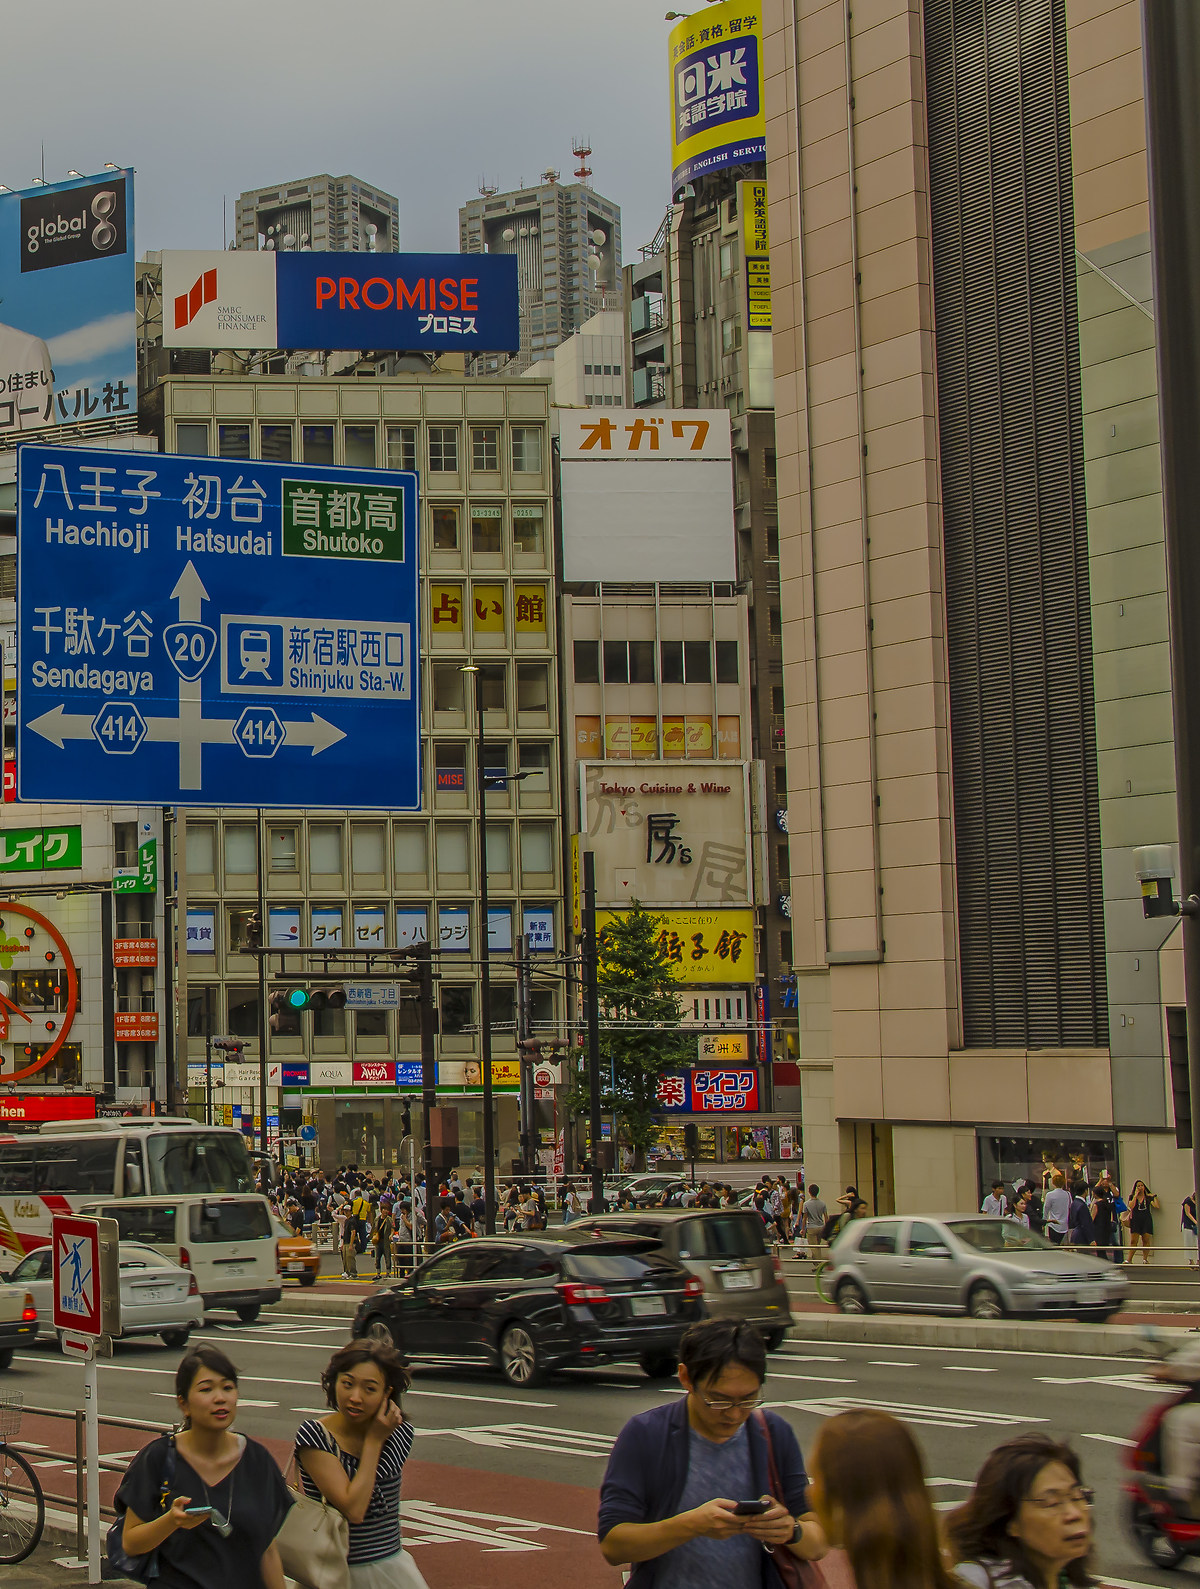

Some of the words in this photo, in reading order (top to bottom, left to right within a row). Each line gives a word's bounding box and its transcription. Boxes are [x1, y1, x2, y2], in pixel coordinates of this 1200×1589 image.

[678, 47, 747, 107] 日米
[679, 89, 748, 132] 英語学院
[693, 152, 729, 172] ENGLISH
[28, 210, 86, 253] global
[316, 277, 478, 311] PROMISE
[217, 314, 266, 322] CONSUMER
[217, 322, 256, 330] FINANCE
[417, 314, 478, 335] プロミス
[579, 417, 709, 450] オガワ
[34, 464, 161, 515] 八王子
[182, 471, 267, 523] 初台
[289, 488, 397, 532] 首都高
[46, 518, 149, 554] Hachioji
[176, 526, 272, 556] Hatsudai
[303, 530, 384, 555] Shutoko
[433, 593, 544, 623] 占い館
[33, 606, 153, 658] 千駄ヶ谷
[174, 634, 205, 661] 20
[289, 626, 404, 668] 新宿駅西口
[32, 661, 153, 696] Sendagaya
[289, 671, 354, 692] Shinjuku
[360, 673, 405, 693] Sta.-W.
[101, 716, 137, 742] 414
[242, 720, 277, 746] 414
[438, 774, 463, 785] MISE
[600, 782, 636, 796] Tokyo
[639, 782, 683, 794] Cuisine
[687, 783, 696, 793] &
[700, 782, 731, 793] Wine
[142, 849, 154, 885] レイク
[116, 879, 136, 889] レイク
[529, 921, 546, 931] 新宿
[349, 988, 396, 998] 西新宿一丁目
[320, 1070, 343, 1079] AQUA
[695, 1071, 754, 1093] ダイコク
[657, 1076, 685, 1106] 薬
[703, 1094, 746, 1108] ドラッグ
[62, 1295, 84, 1313] 横断禁止
